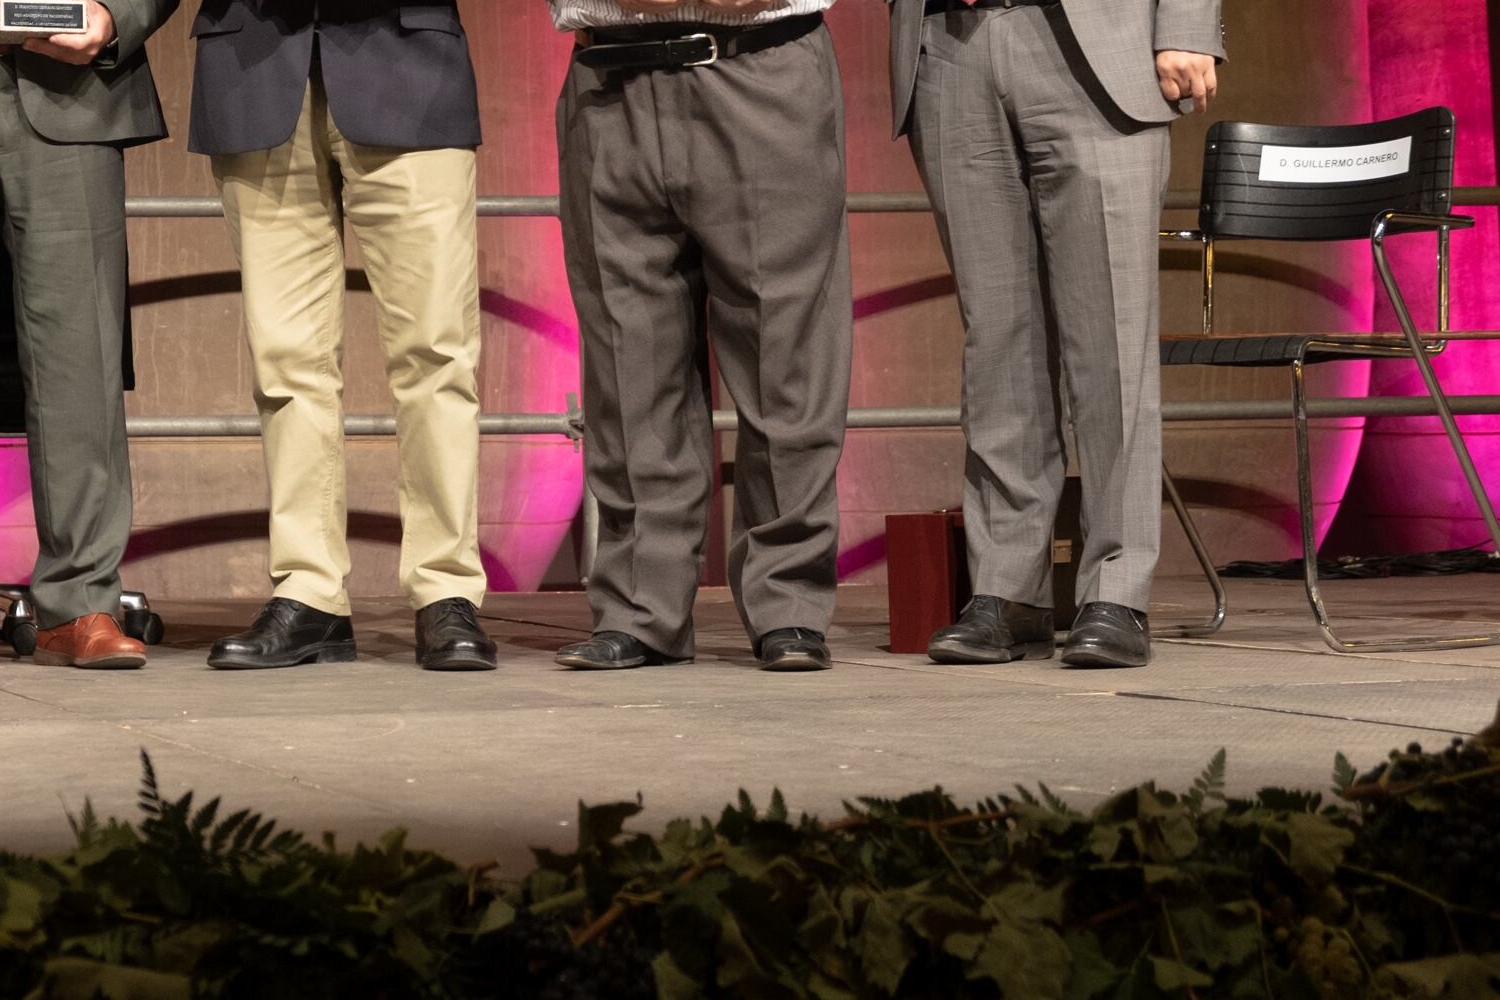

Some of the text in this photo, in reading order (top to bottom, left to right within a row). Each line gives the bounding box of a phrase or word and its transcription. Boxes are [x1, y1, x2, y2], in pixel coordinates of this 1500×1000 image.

[1279, 152, 1398, 168] D. GUILLERMO CARNERO
